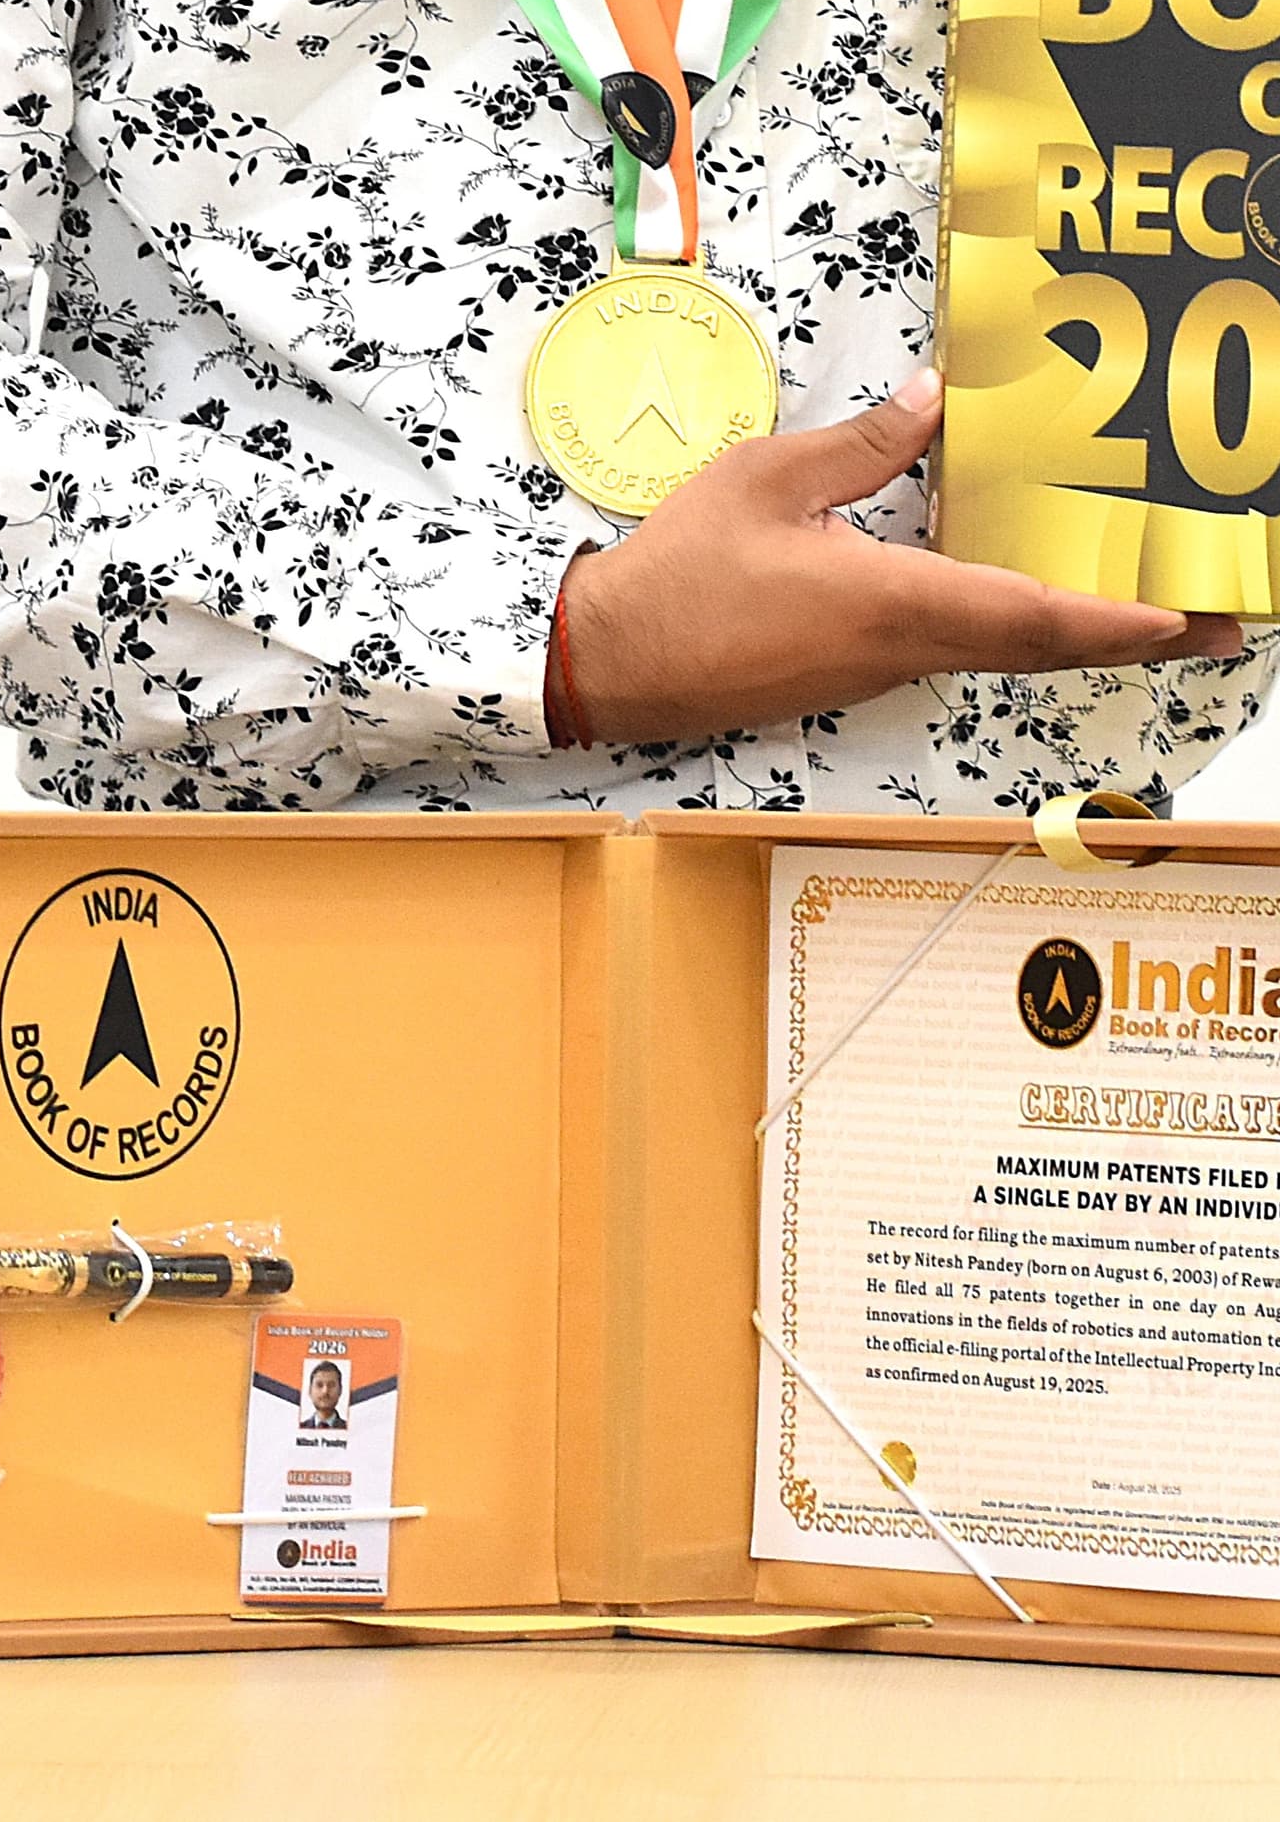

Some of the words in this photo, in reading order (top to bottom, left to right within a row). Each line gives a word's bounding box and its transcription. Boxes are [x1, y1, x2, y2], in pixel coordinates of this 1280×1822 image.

[1247, 202, 1278, 249] BOOK
[595, 289, 720, 339] INDIA
[548, 400, 604, 478] BOOK
[600, 468, 639, 494] OF
[83, 887, 158, 928] INDIA
[1044, 944, 1076, 961] INDIA
[1024, 993, 1042, 1030] BOOK
[1041, 1025, 1056, 1039] OF
[1058, 995, 1096, 1040] RECORDS
[1109, 1015, 1169, 1038] Book
[1176, 1019, 1200, 1040] of
[11, 1023, 69, 1135] BOOK
[67, 1117, 109, 1160] OF
[118, 1026, 228, 1163] RECORDS
[996, 1156, 1099, 1180] MAXIMUM
[1107, 1162, 1201, 1186] PATENTS
[1208, 1168, 1269, 1189] FILED
[973, 1185, 987, 1204] A
[994, 1186, 1070, 1209] SINGLE
[1077, 1191, 1118, 1211] DAY
[1125, 1193, 1152, 1213] BY
[1158, 1196, 1188, 1216] AN
[868, 1220, 896, 1236] The
[900, 1224, 949, 1240] record
[953, 1225, 975, 1241] for
[978, 1226, 1019, 1248] filing
[1022, 1229, 1048, 1246] the
[1051, 1233, 1130, 1251] maximum
[1134, 1238, 1196, 1255] number
[1199, 1240, 1217, 1257] of
[1218, 1244, 1280, 1261] patents
[867, 1252, 889, 1265] set
[893, 1250, 911, 1270] by
[915, 1252, 964, 1269] Nitesh
[967, 1255, 1024, 1277] Pandey
[1027, 1259, 1067, 1277] (born
[1070, 1265, 1091, 1278] on
[1094, 1263, 1149, 1283] August
[1153, 1267, 1168, 1284] 6,
[1172, 1268, 1218, 1288] 2003)
[1221, 1271, 1239, 1286] of
[866, 1277, 886, 1293] He
[895, 1279, 927, 1296] filed
[935, 1282, 954, 1298] all
[962, 1283, 981, 1299] 75
[989, 1289, 1046, 1305] patents
[1055, 1292, 1120, 1310] together
[1129, 1294, 1144, 1310] in
[1152, 1300, 1181, 1312] one
[1189, 1298, 1217, 1318] day
[1226, 1304, 1246, 1316] on
[308, 1340, 347, 1354] 2026
[866, 1306, 954, 1326] innovations
[958, 1312, 973, 1328] in
[977, 1314, 1003, 1330] the
[1007, 1315, 1048, 1333] fields
[1052, 1318, 1068, 1334] of
[1071, 1320, 1134, 1338] robotics
[1138, 1325, 1167, 1340] and
[1171, 1329, 1262, 1347] automation
[866, 1335, 890, 1351] the
[892, 1337, 944, 1355] official
[946, 1341, 999, 1362] e-filing
[1001, 1346, 1046, 1363] portal
[1048, 1348, 1066, 1363] of
[1065, 1349, 1092, 1366] the
[1094, 1350, 1185, 1372] Intellectual
[1187, 1356, 1256, 1380] Property
[865, 1366, 882, 1380] as
[883, 1366, 960, 1386] confirmed
[961, 1374, 982, 1387] on
[983, 1372, 1036, 1392] August
[1039, 1375, 1063, 1394] 19,
[1065, 1377, 1109, 1395] 2025.
[1092, 1480, 1111, 1490] Date
[302, 1539, 357, 1560] India
